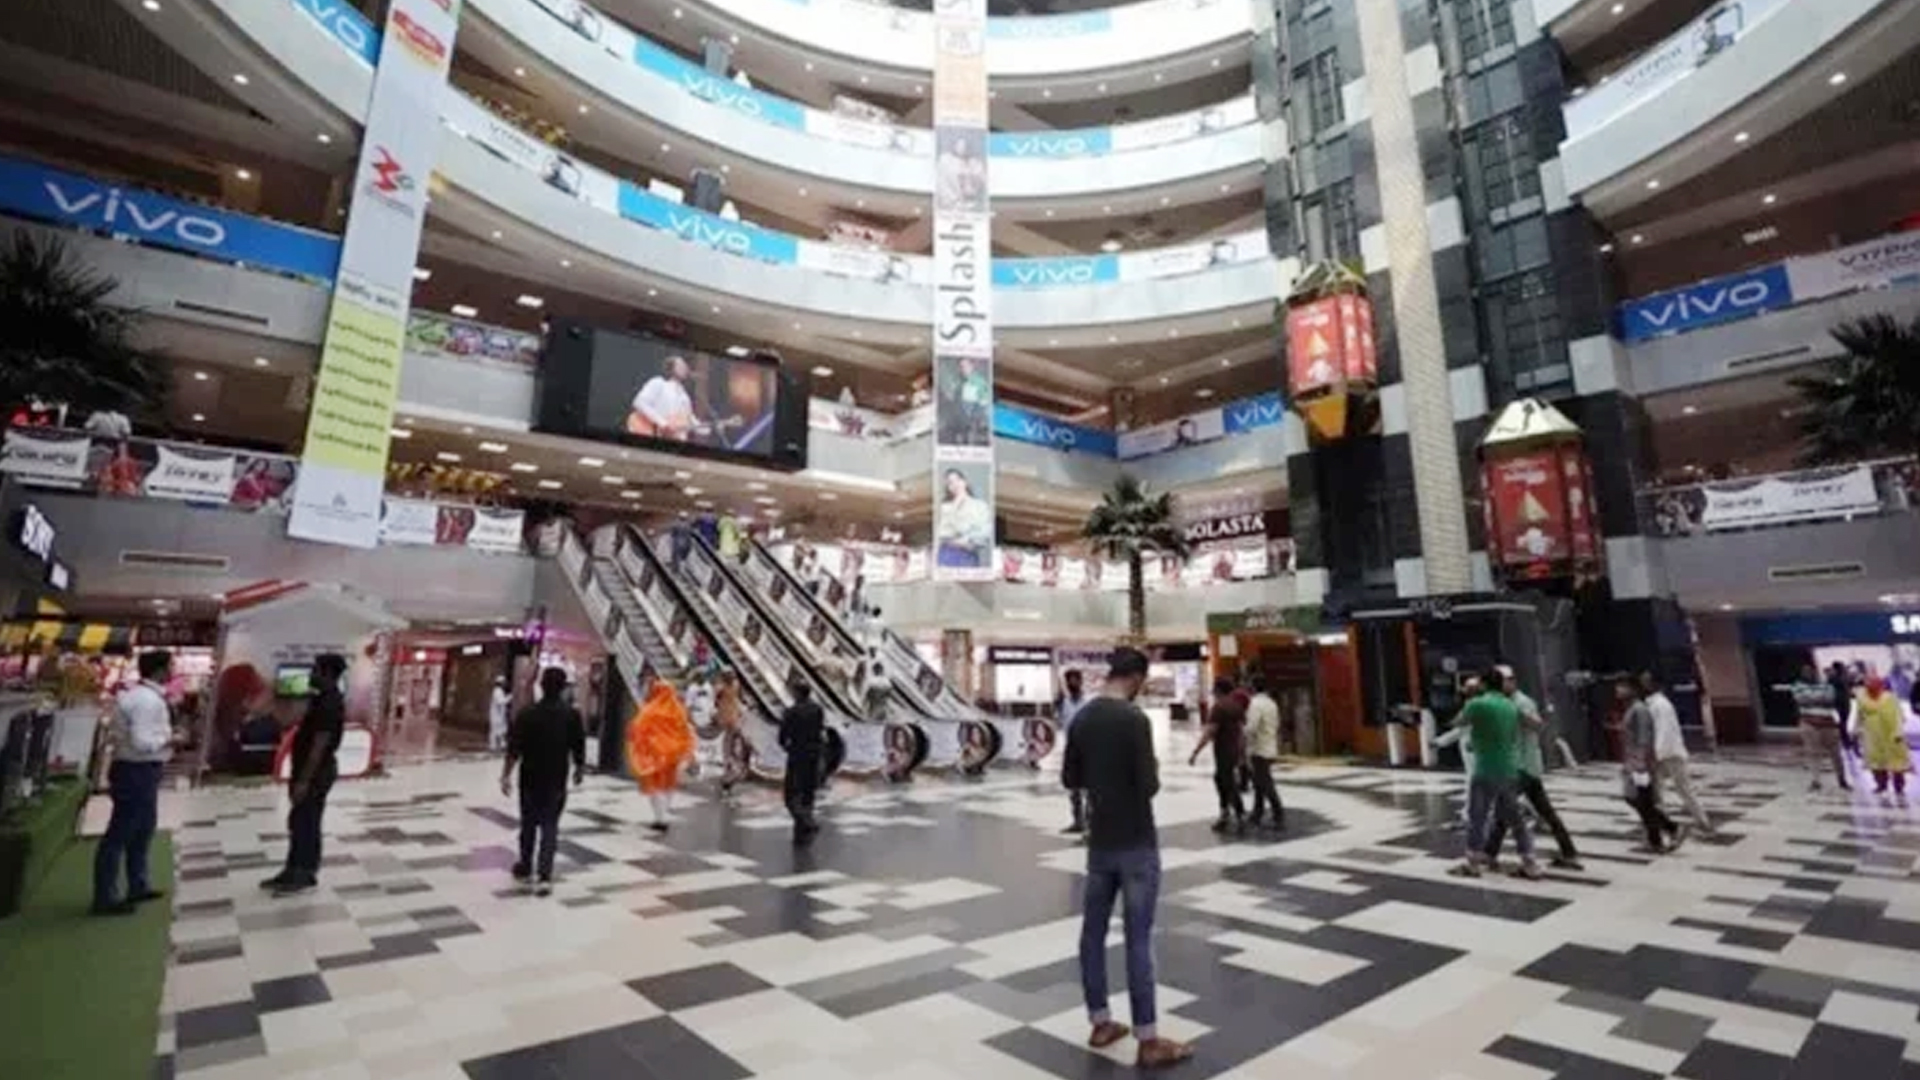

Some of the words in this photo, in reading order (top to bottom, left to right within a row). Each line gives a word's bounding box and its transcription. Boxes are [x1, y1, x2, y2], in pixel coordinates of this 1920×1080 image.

[683, 70, 761, 115] vivo
[1009, 136, 1088, 155] vivo
[45, 182, 225, 245] vivo
[668, 210, 751, 249] vivo
[938, 223, 987, 343] Splash
[1013, 262, 1094, 283] vivo
[1640, 279, 1769, 326] vivo
[1020, 417, 1077, 445] vivo
[1233, 400, 1281, 424] viv
